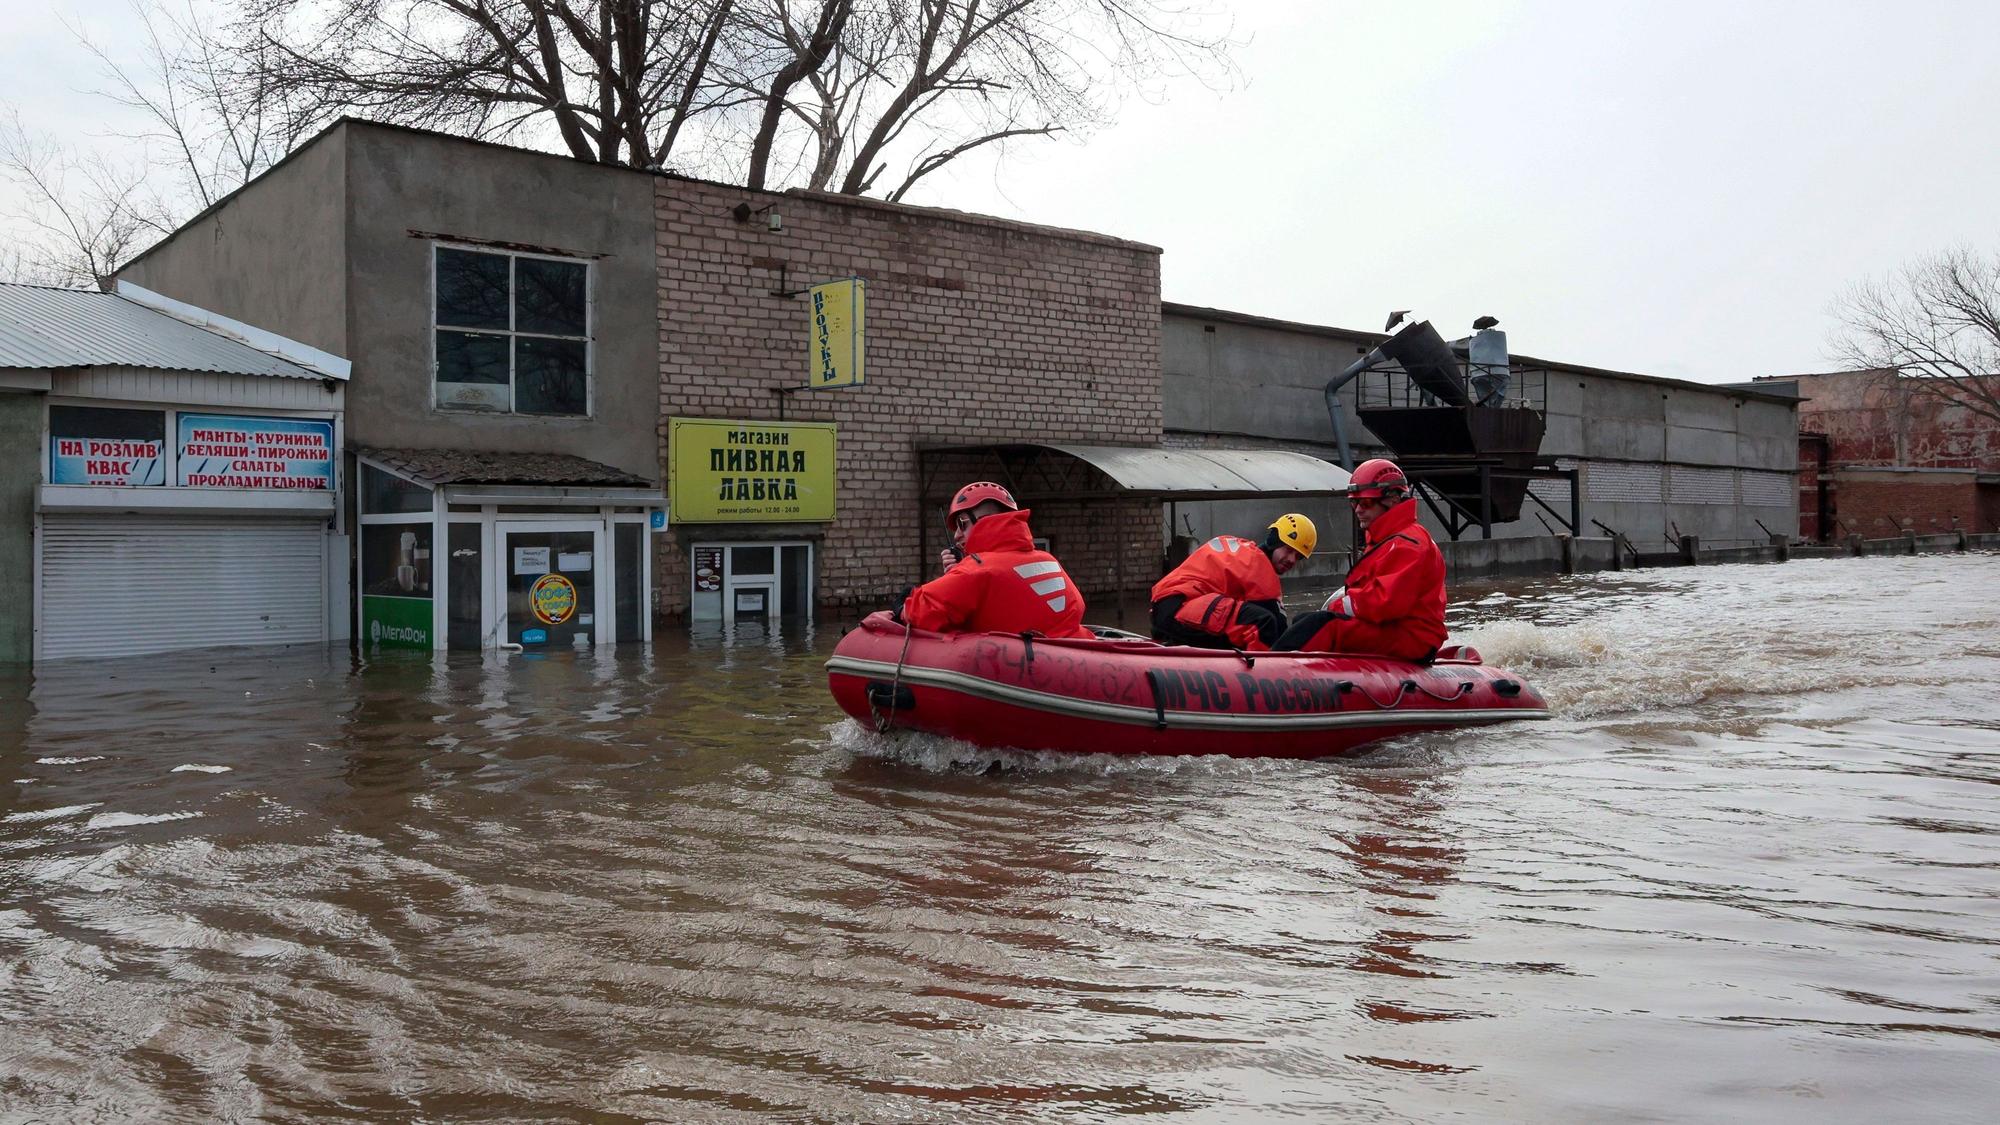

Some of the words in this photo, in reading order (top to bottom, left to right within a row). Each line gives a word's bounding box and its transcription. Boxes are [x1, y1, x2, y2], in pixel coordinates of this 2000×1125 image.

[813, 291, 837, 382] ПРОДУКТЫ
[192, 430, 247, 443] МАНТЫ
[255, 432, 322, 446] КУРНИКИ
[728, 431, 789, 445] магазин
[60, 441, 83, 456] НА
[90, 443, 157, 458] РОЗЛИВ
[187, 445, 249, 458] БЕЛЯШИ
[258, 447, 328, 460] ПИРОЖКИ
[232, 460, 286, 473] САЛАТЫ
[710, 448, 805, 473] ПИВНАЯ
[87, 461, 131, 476] КВАС
[188, 474, 327, 489] ПРОХЛАДИТЕЛЬНЫЕ
[719, 477, 798, 501] ЛАВКА
[739, 506, 762, 514] работы
[1150, 667, 1231, 711] МЧС
